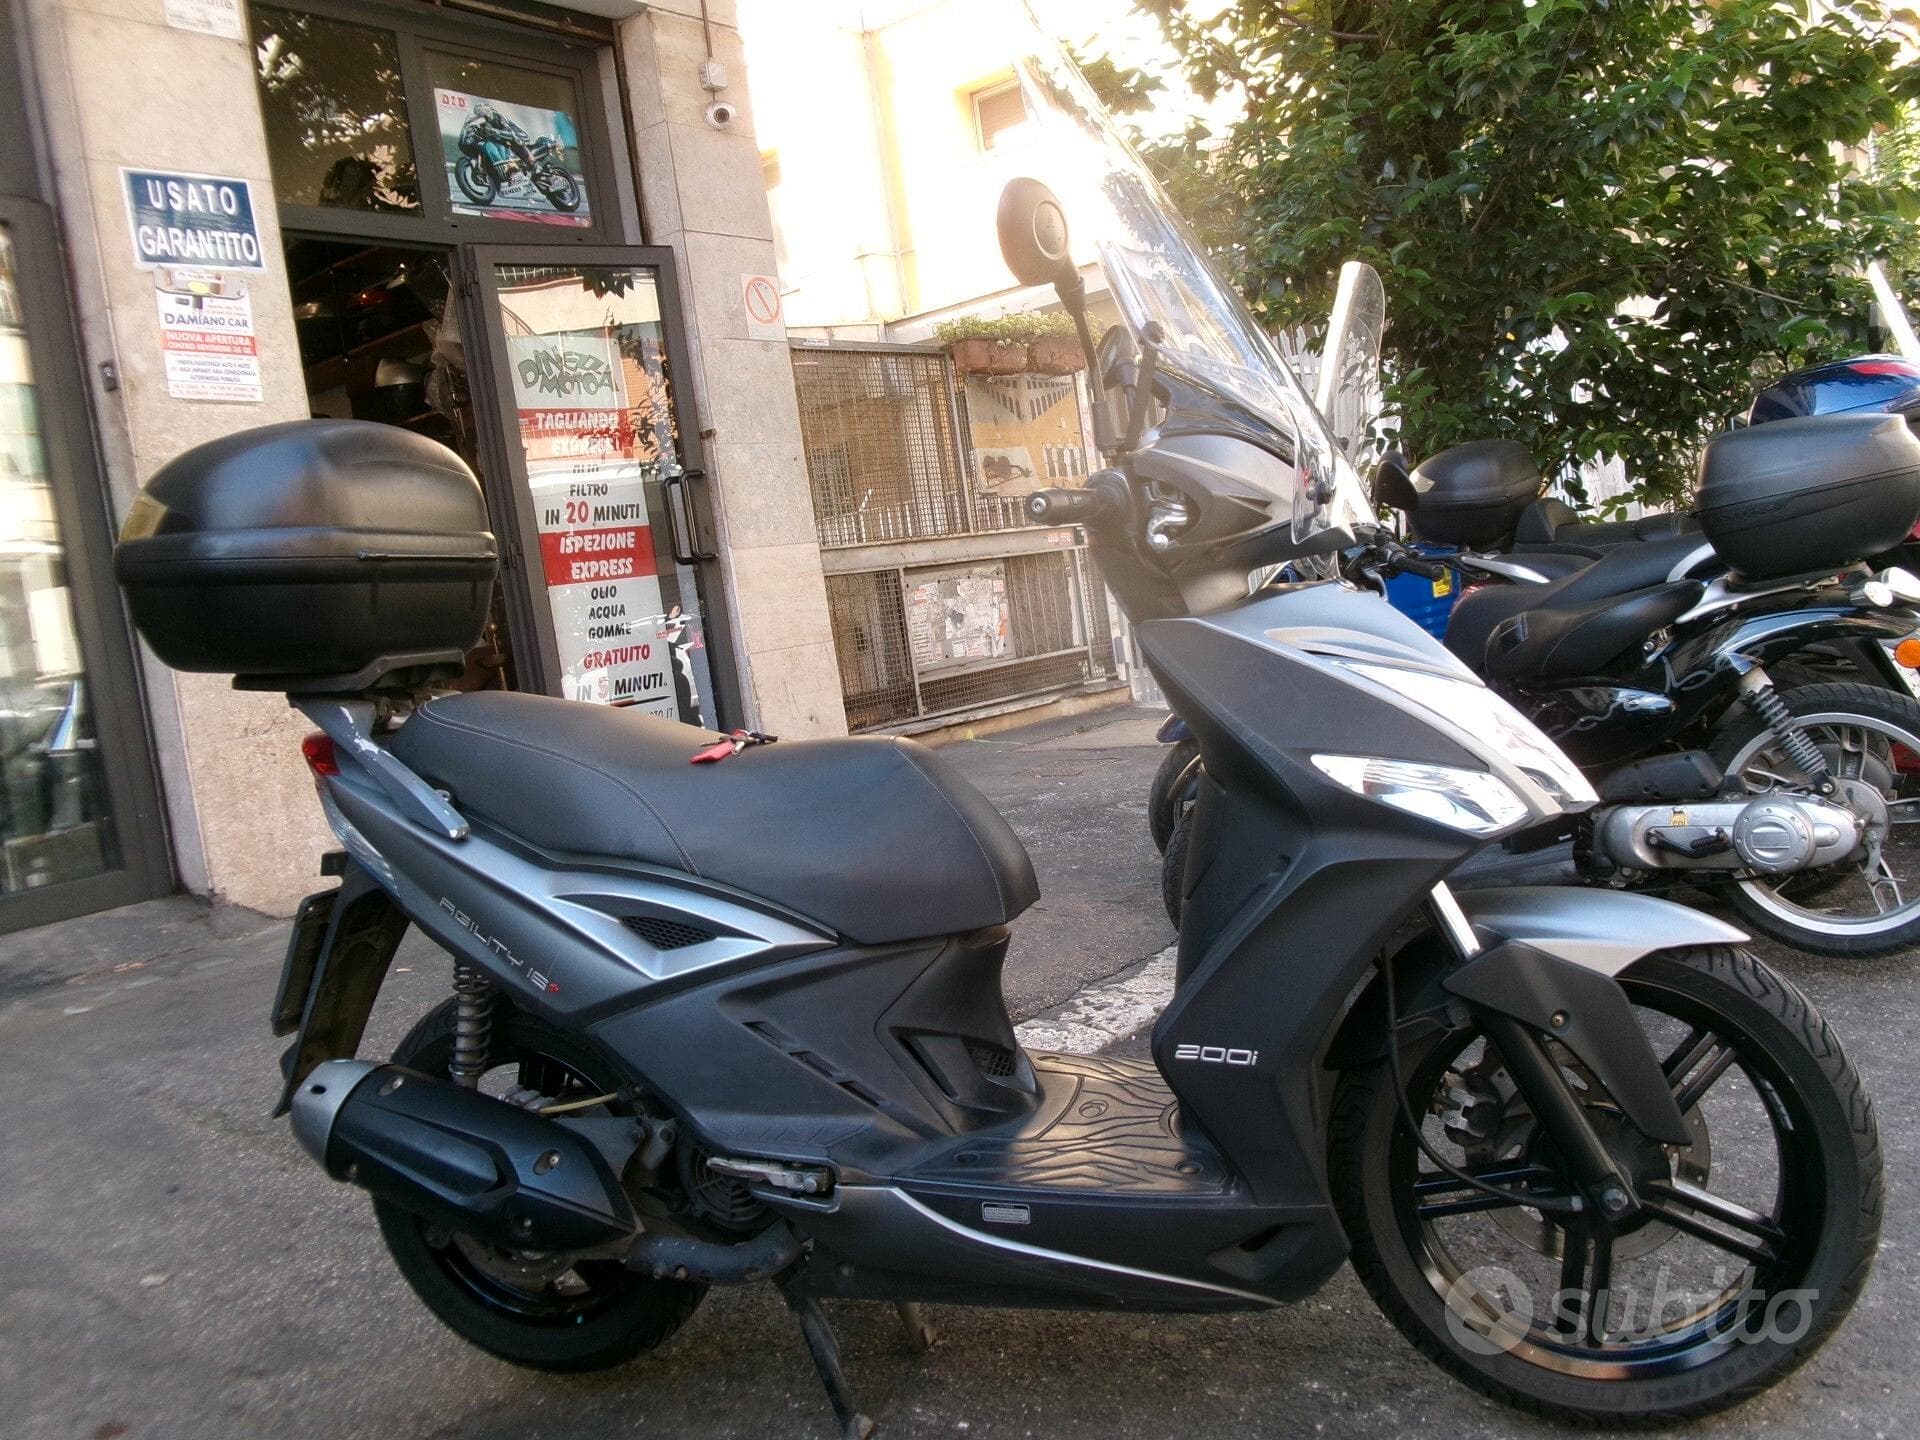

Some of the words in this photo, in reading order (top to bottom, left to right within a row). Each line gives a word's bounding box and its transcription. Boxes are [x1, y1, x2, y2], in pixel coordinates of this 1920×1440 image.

[147, 179, 236, 215] USATO
[139, 225, 258, 262] GARANTITO
[164, 313, 226, 326] DAMIANO
[227, 317, 249, 328] CAR
[166, 331, 203, 342] NUOVA
[204, 333, 250, 345] APERTURA
[536, 412, 619, 430] TAGLIANDO
[570, 483, 608, 497] FILTRO
[545, 509, 560, 526] IN
[566, 500, 590, 524] 20
[593, 503, 640, 522] MINUTI
[560, 531, 635, 554] ISPEZIONE
[571, 557, 633, 580] EXPRESS
[591, 585, 617, 600] OLIO
[589, 604, 626, 620] ACQUA
[588, 623, 632, 640] GOMME
[583, 644, 651, 670] GRATUITO
[576, 684, 592, 701] IN
[440, 896, 524, 967] AGILITY
[1175, 1044, 1259, 1066] 200i
